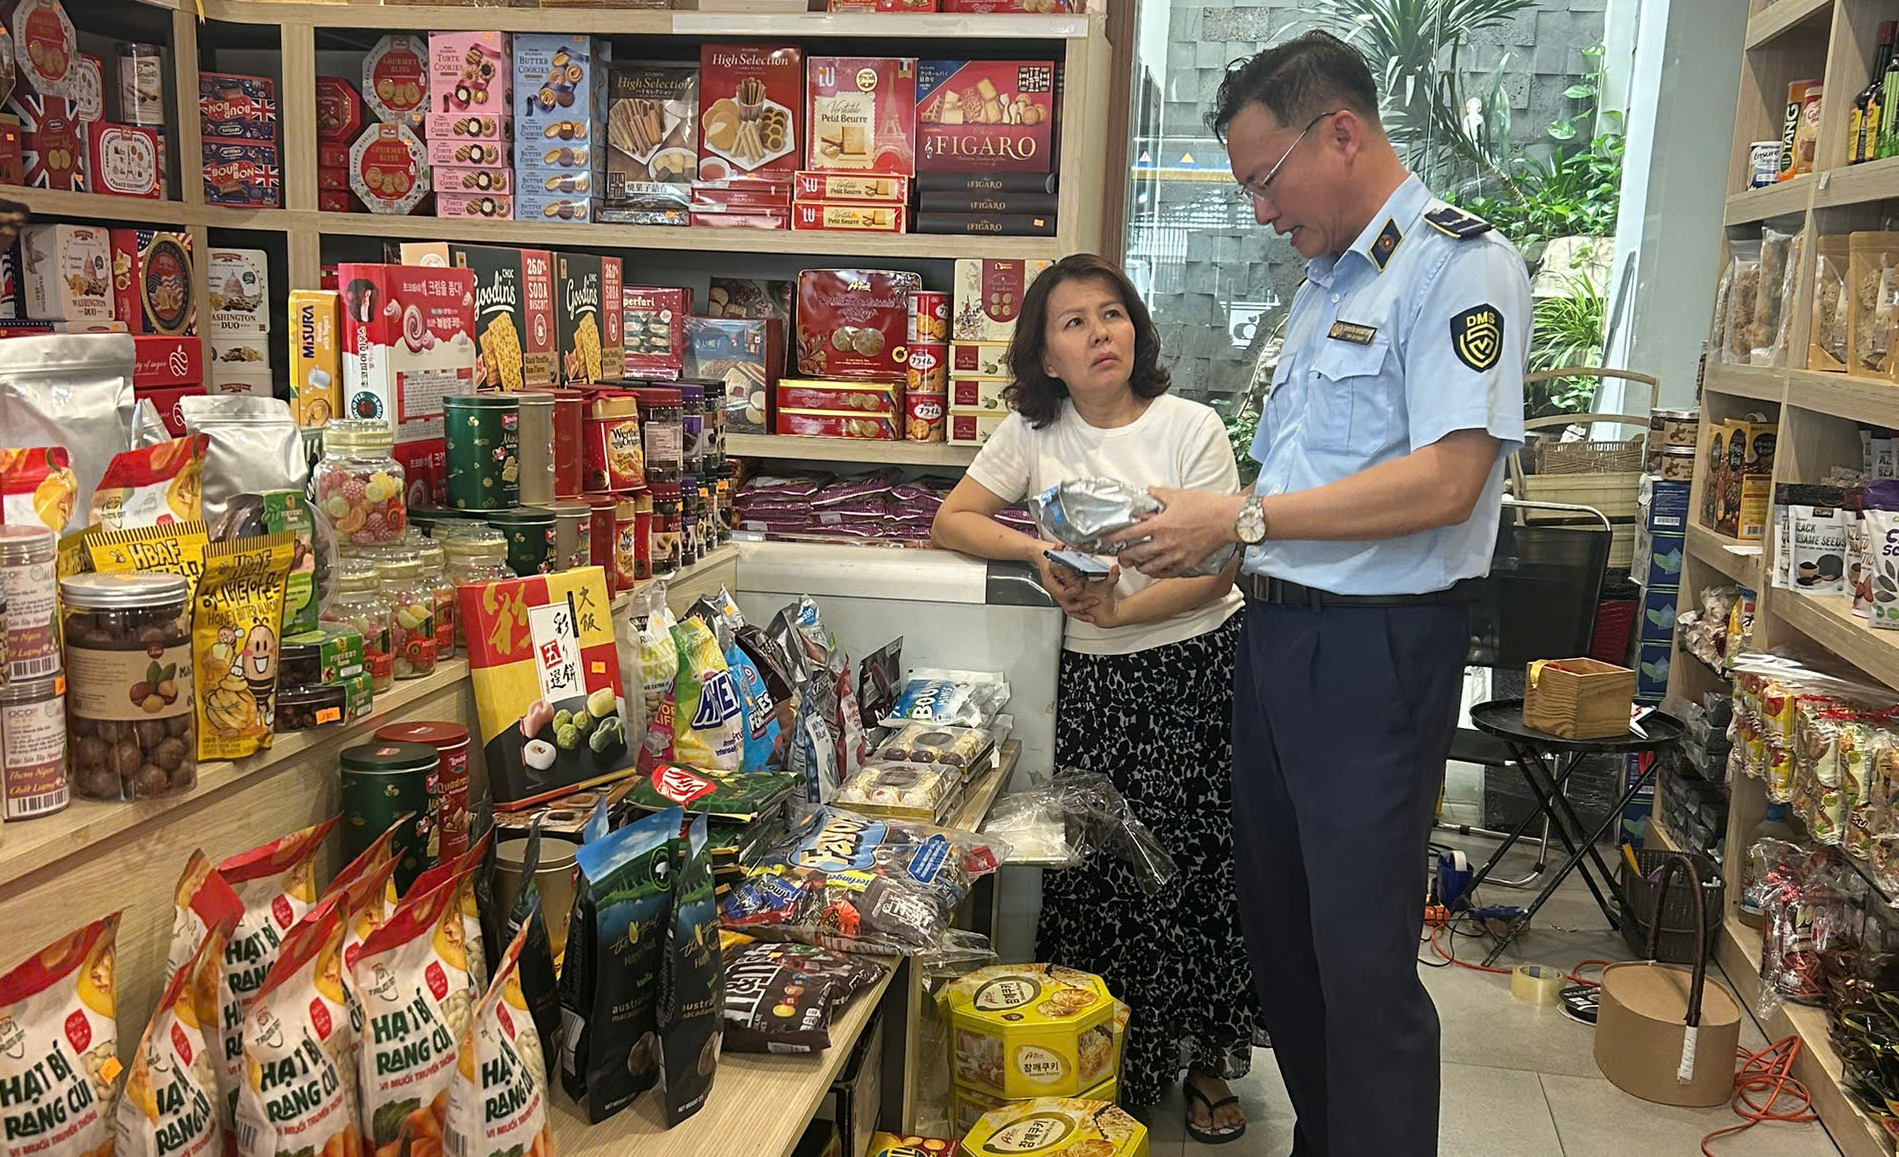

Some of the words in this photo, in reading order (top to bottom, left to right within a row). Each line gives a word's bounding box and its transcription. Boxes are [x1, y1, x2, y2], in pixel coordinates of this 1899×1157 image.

[437, 54, 460, 63] TORTE
[519, 57, 549, 66] BUTTER
[713, 54, 738, 69] High
[739, 54, 788, 67] Selection
[434, 63, 463, 72] COOKIES
[518, 65, 550, 74] COOKIES
[618, 76, 644, 91] High
[821, 114, 840, 124] Petit
[1783, 103, 1800, 153] TANG
[935, 135, 1037, 161] FIGARO
[211, 162, 239, 178] BOUR
[232, 168, 255, 180] BON
[805, 178, 819, 193] LU
[970, 180, 1003, 190] FIGARO
[973, 201, 1006, 211] FIGARO
[803, 208, 816, 223] LU
[970, 222, 1003, 232] FIGARO
[528, 282, 548, 299] SODA
[605, 287, 619, 300] SODA
[83, 307, 97, 317] DUO
[529, 299, 548, 311] BISCUIT
[211, 313, 257, 323] ASHINGTON
[1466, 311, 1496, 328] DMS
[221, 322, 240, 331] DUO
[1821, 536, 1847, 547] SEEDS
[126, 537, 181, 571] HBAF
[225, 930, 268, 966] HẠT
[371, 1004, 421, 1045] HẠT
[375, 1036, 431, 1077] RANG
[0, 1061, 52, 1108] HẠT
[45, 1038, 73, 1083] BÍ
[260, 1046, 310, 1093] HẠT
[1022, 1061, 1060, 1074] 참깨쿠키
[266, 1079, 322, 1123] RANG
[4, 1095, 68, 1142] RANG
[1017, 1119, 1050, 1149] 참깨쿠키
